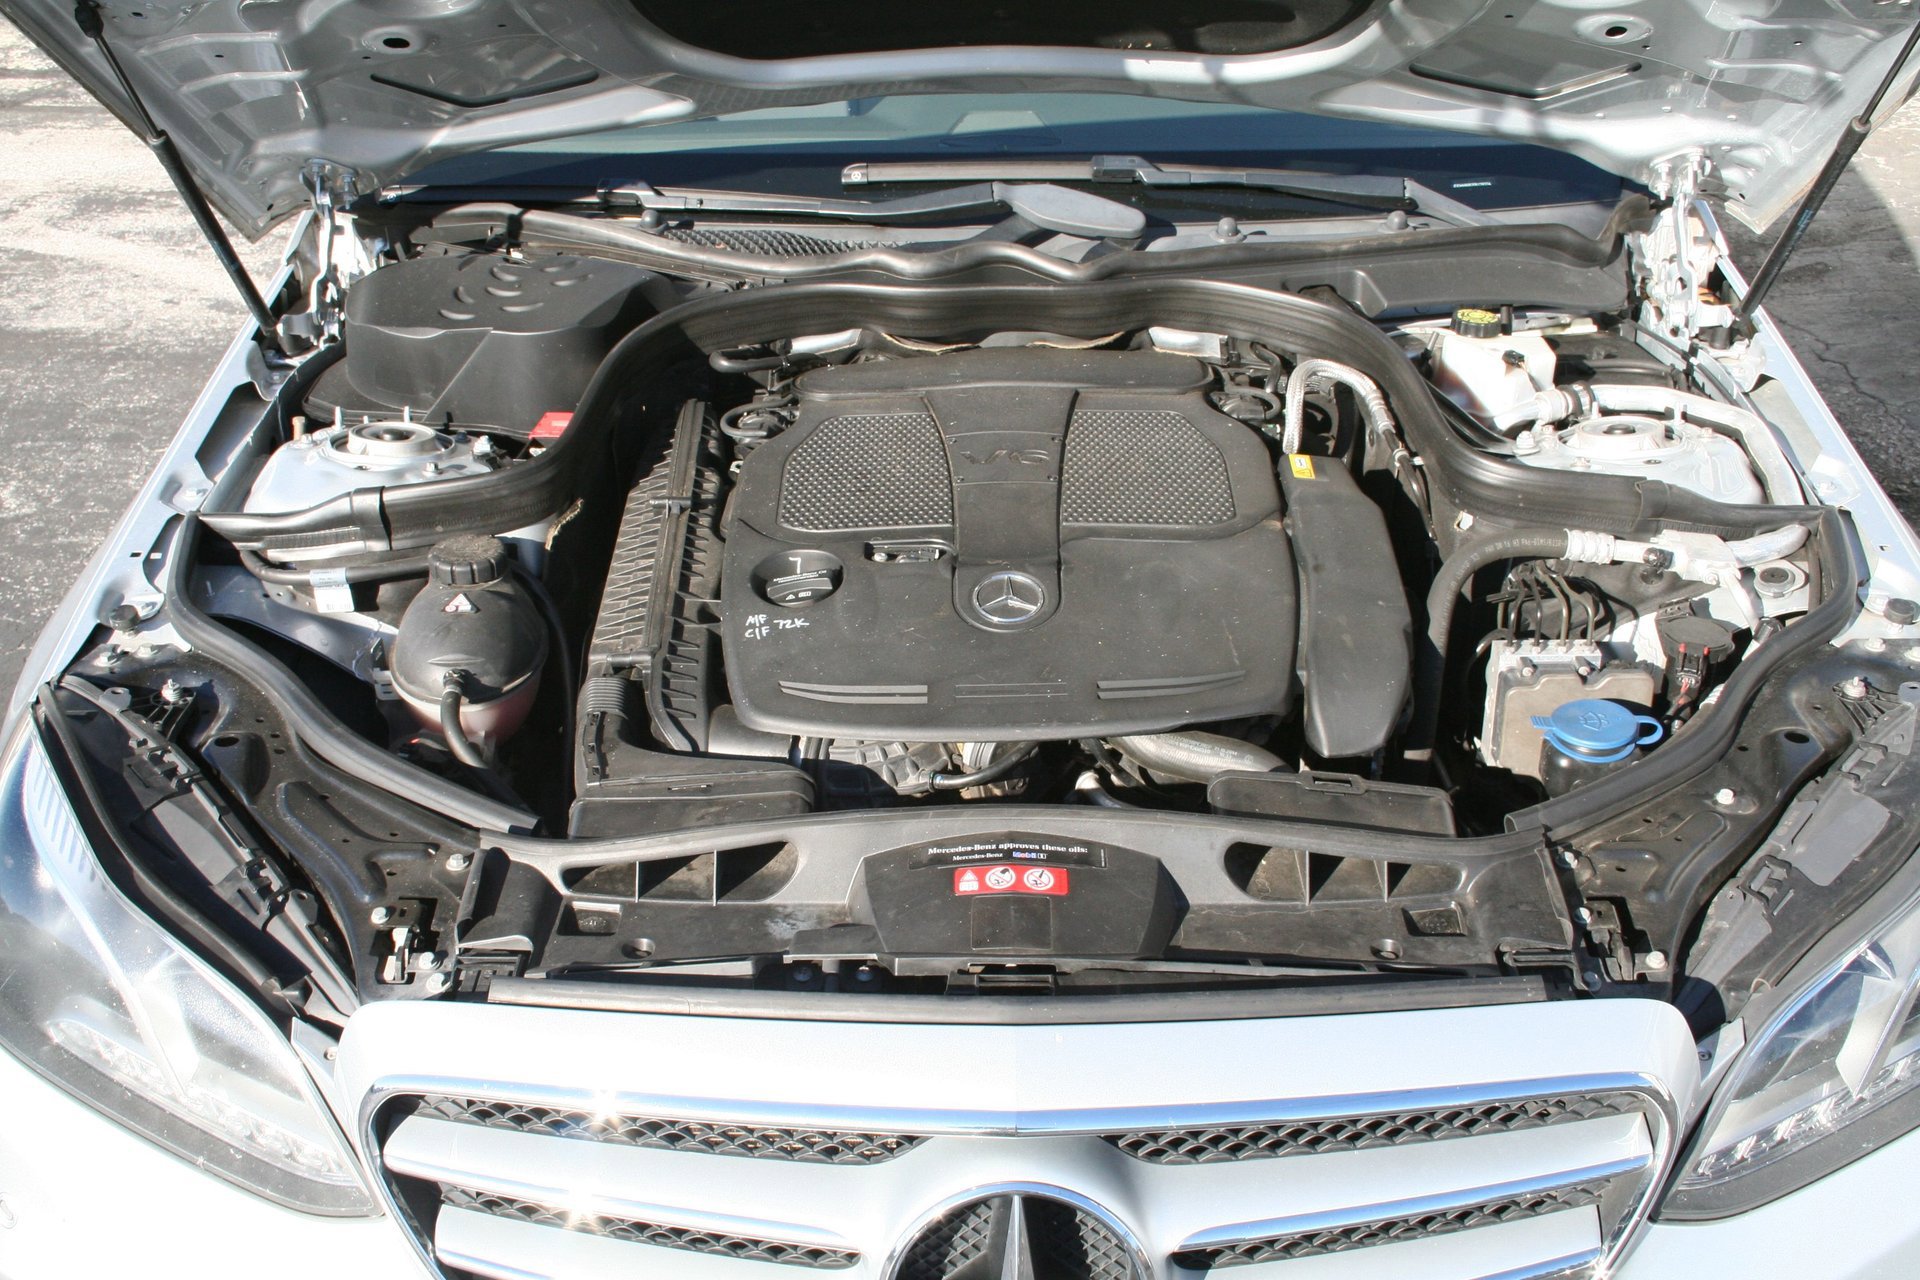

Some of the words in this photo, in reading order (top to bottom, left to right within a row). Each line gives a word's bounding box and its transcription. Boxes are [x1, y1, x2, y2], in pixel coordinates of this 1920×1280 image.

[960, 449, 1049, 464] V6
[773, 618, 810, 629] 72K
[927, 843, 997, 855] Mercedes-Benz
[998, 842, 1040, 850] approves
[1042, 844, 1067, 852] these
[952, 852, 1004, 861] Mercedes-Benz
